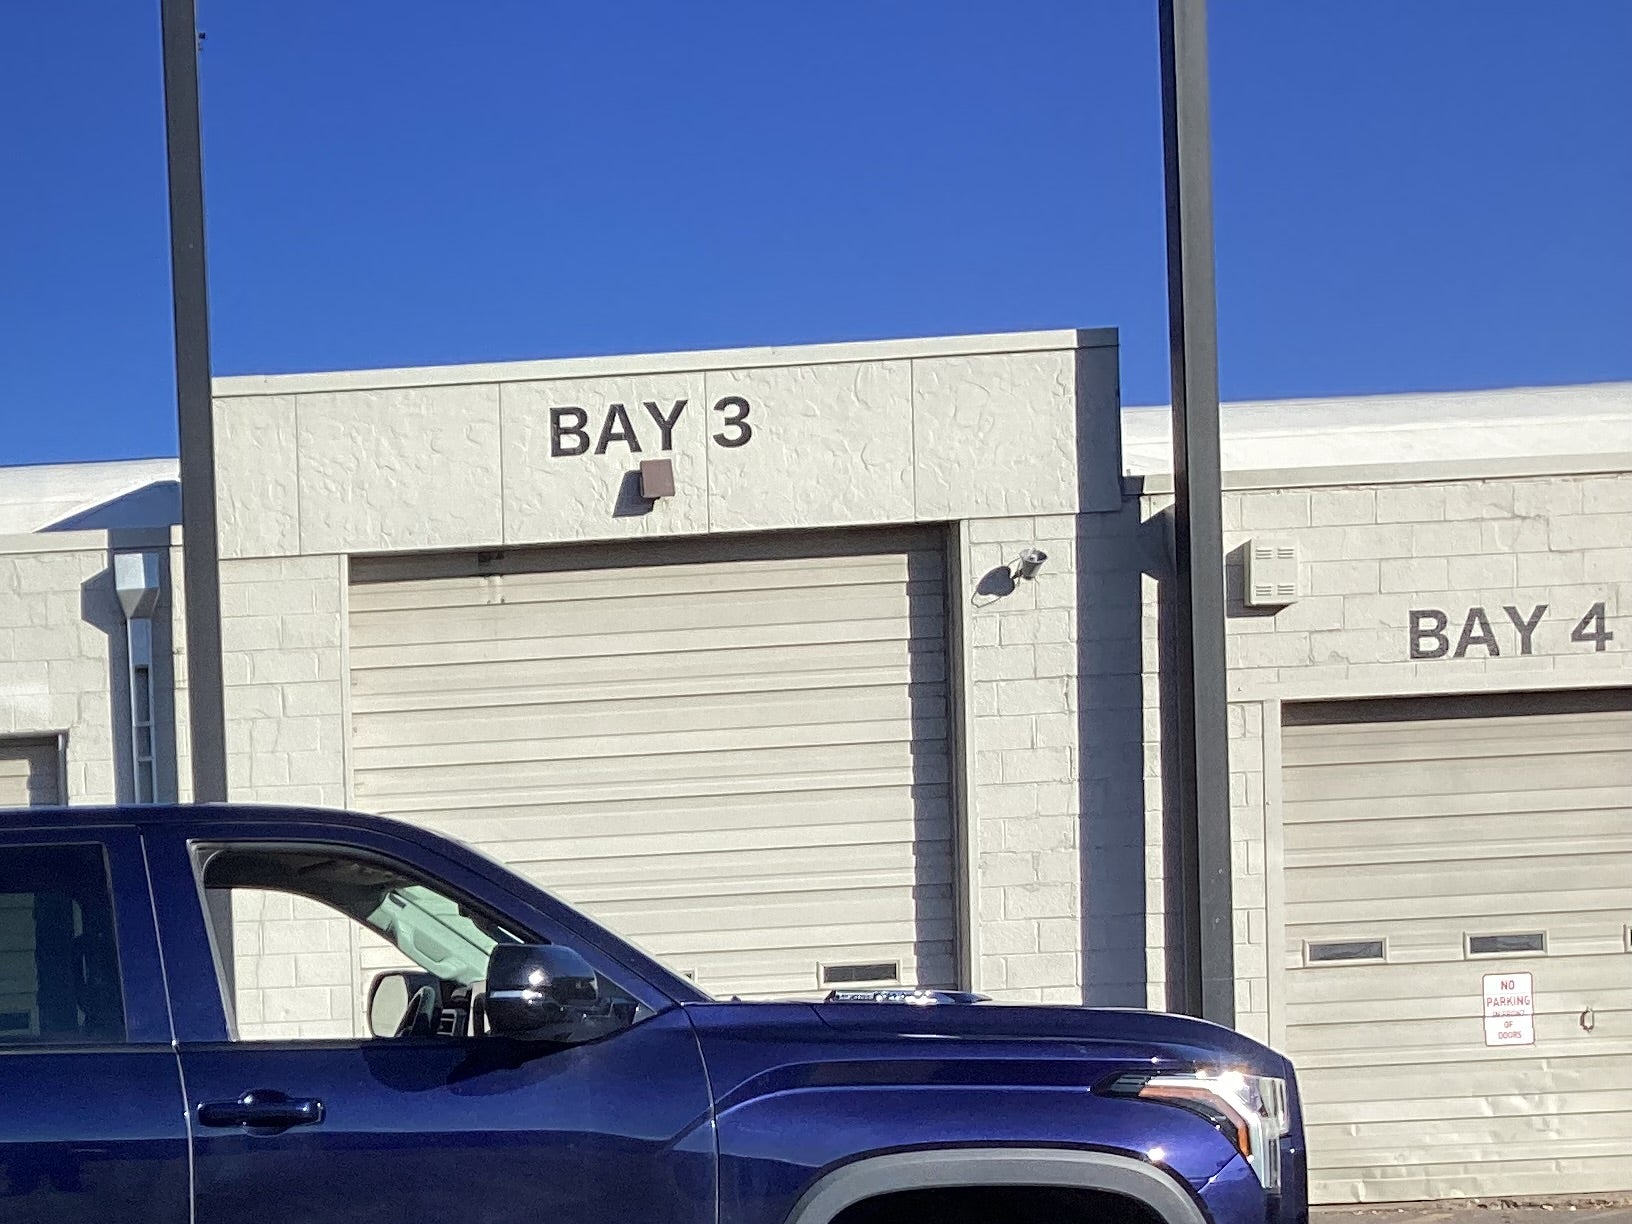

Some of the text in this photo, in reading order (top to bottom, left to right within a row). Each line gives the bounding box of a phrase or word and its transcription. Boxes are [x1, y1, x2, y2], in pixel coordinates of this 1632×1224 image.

[550, 396, 752, 457] BAY 3
[1409, 602, 1614, 659] BAY 4
[1487, 996, 1530, 1006] PARKING
[1501, 980, 1515, 990] NO
